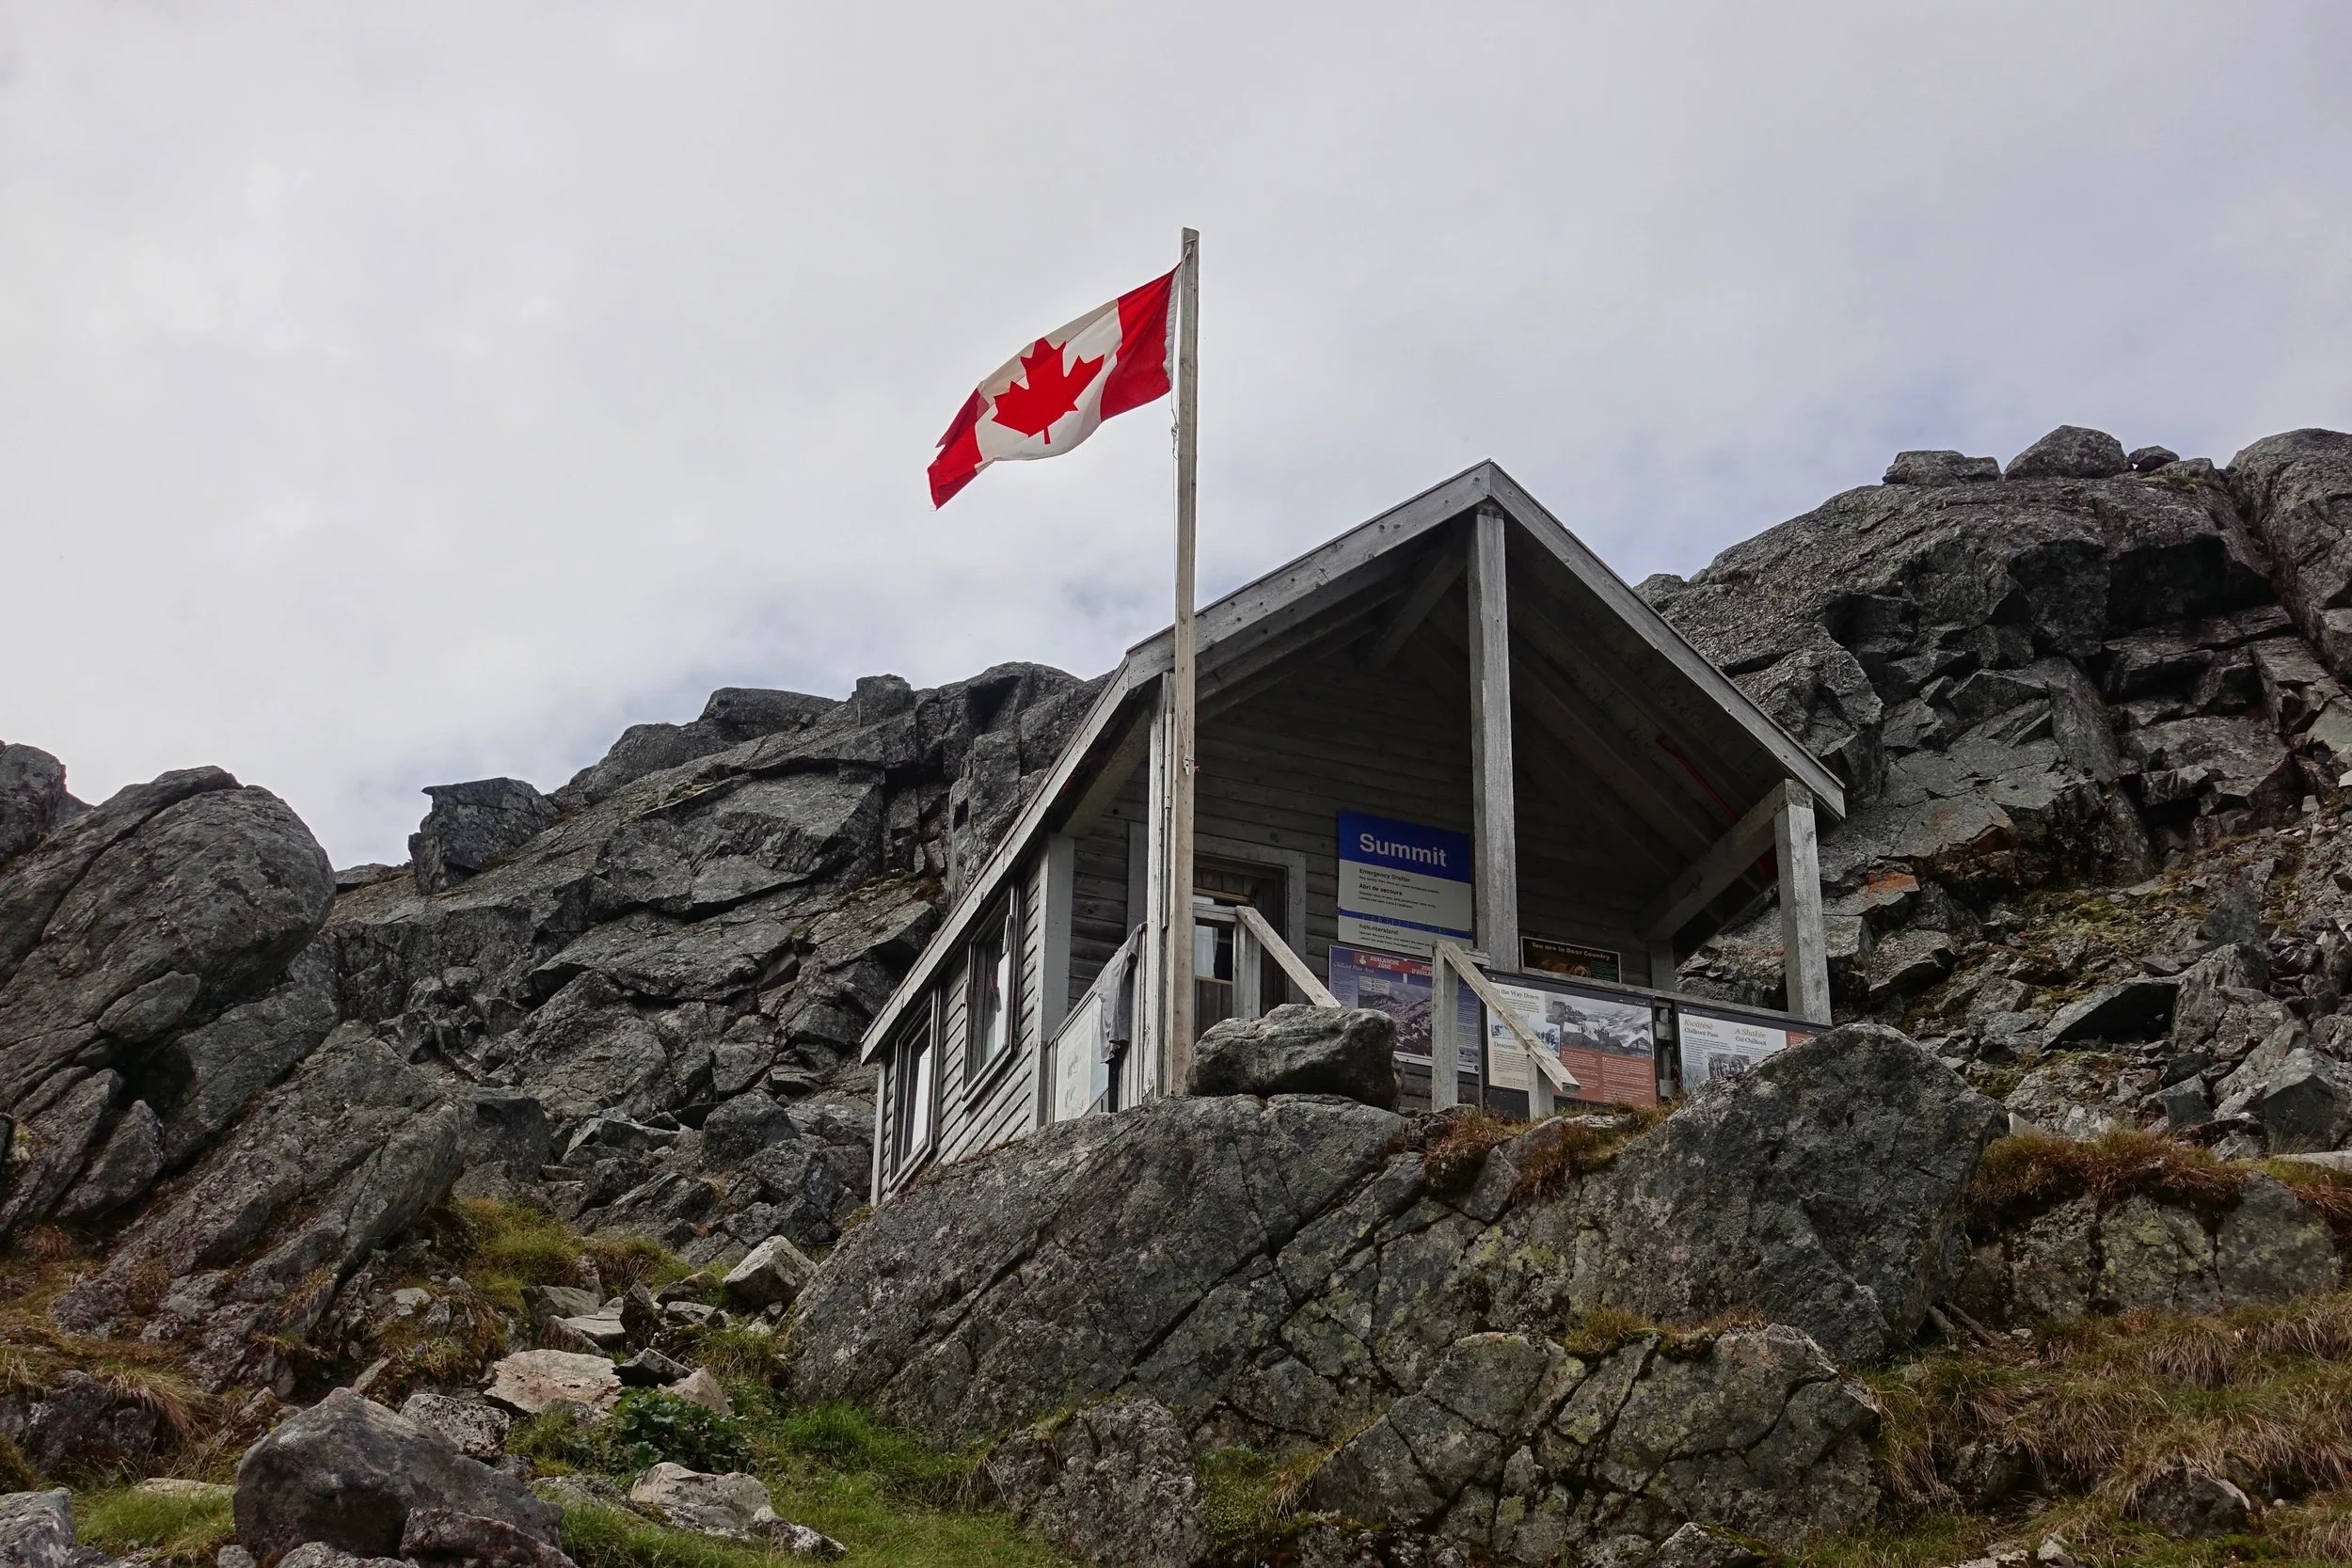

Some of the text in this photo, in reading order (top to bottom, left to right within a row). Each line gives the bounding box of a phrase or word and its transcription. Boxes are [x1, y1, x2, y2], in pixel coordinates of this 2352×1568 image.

[1359, 832, 1447, 867] Summit
[1359, 868, 1411, 883] Emergency Shelter
[1380, 888, 1403, 896] secours
[1583, 950, 1611, 961] Country
[1370, 955, 1400, 966] AVALANCHE
[1377, 961, 1391, 970] ZONE
[1421, 964, 1432, 973] ZON
[1684, 1027, 1707, 1036] Chilkoot
[1744, 1037, 1767, 1046] Chilkoot
